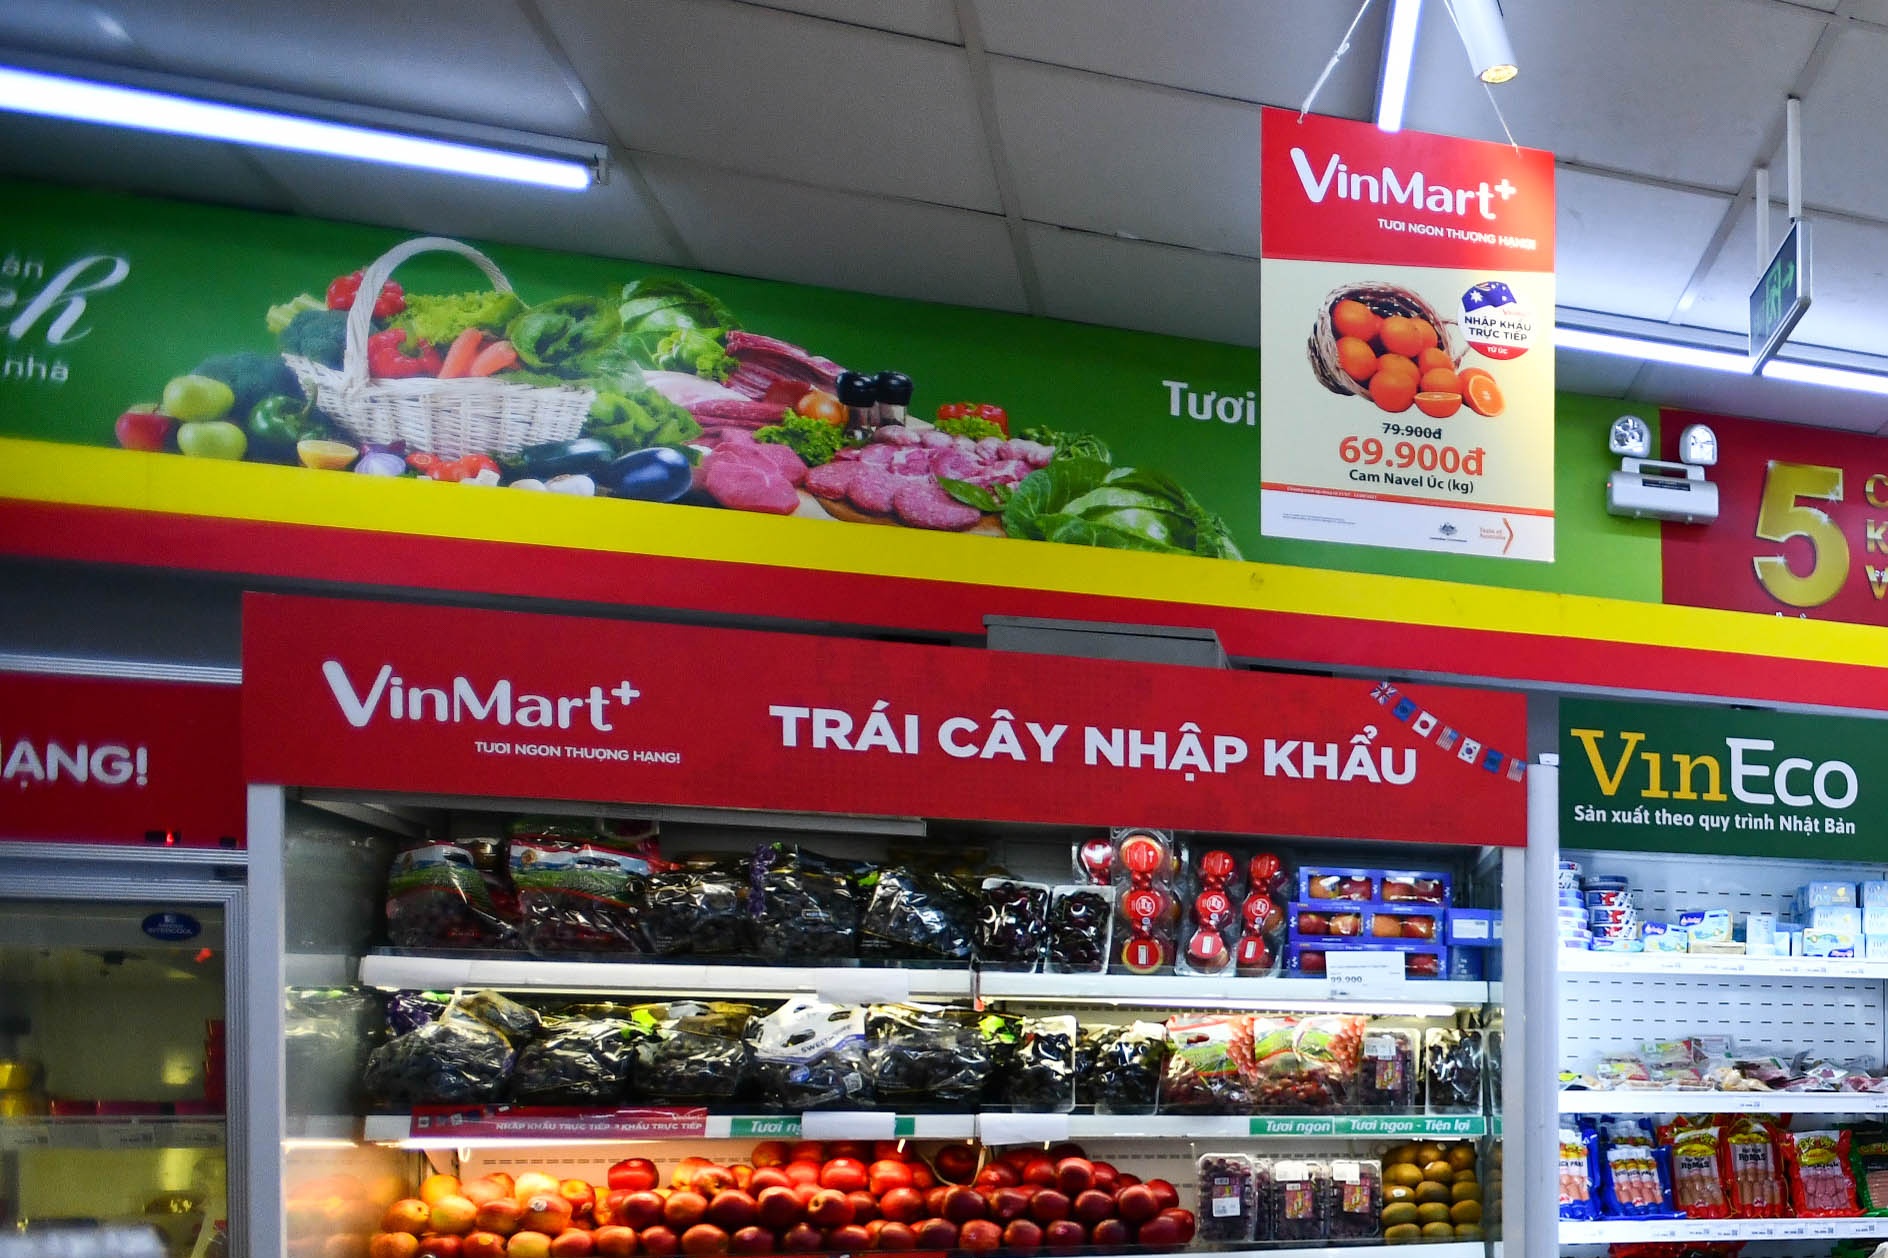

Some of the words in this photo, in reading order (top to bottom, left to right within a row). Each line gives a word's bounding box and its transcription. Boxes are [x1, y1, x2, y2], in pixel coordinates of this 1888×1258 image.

[1290, 147, 1517, 221] VinMart+
[1408, 223, 1444, 237] NGON
[1162, 380, 1256, 426] Tươi
[1382, 422, 1442, 440] 79.900đ
[1339, 435, 1486, 477] 69.900đ
[1350, 469, 1380, 483] Cam
[1384, 472, 1423, 487] Navel
[1427, 475, 1444, 489] Úc
[1447, 478, 1474, 494] (kg)
[1752, 459, 1850, 608] 5
[322, 660, 641, 731] VinMart+
[515, 743, 561, 757] NGON
[565, 746, 629, 762] THƯỢNG
[633, 750, 681, 765] HẠNG!
[769, 699, 919, 755] TRÁI
[937, 707, 1068, 764] CÂY
[1084, 721, 1250, 783] NHẬP
[1264, 723, 1418, 786] KHẨU
[1571, 728, 1858, 809] VinEco
[1574, 804, 1607, 823] Sản
[1611, 804, 1651, 825] xuất
[1655, 808, 1694, 828] theo
[1699, 813, 1730, 832] quy
[1735, 813, 1775, 832] trình
[1779, 816, 1821, 836] Nhật
[1824, 817, 1856, 835] Bản
[751, 1120, 782, 1133] Tươi
[1266, 1119, 1293, 1131] Tươi
[1296, 1121, 1331, 1135] ngon
[1350, 1119, 1377, 1131] Tươi
[1379, 1121, 1413, 1134] ngon
[1425, 1119, 1451, 1133] Tiện
[1454, 1119, 1471, 1132] lợi
